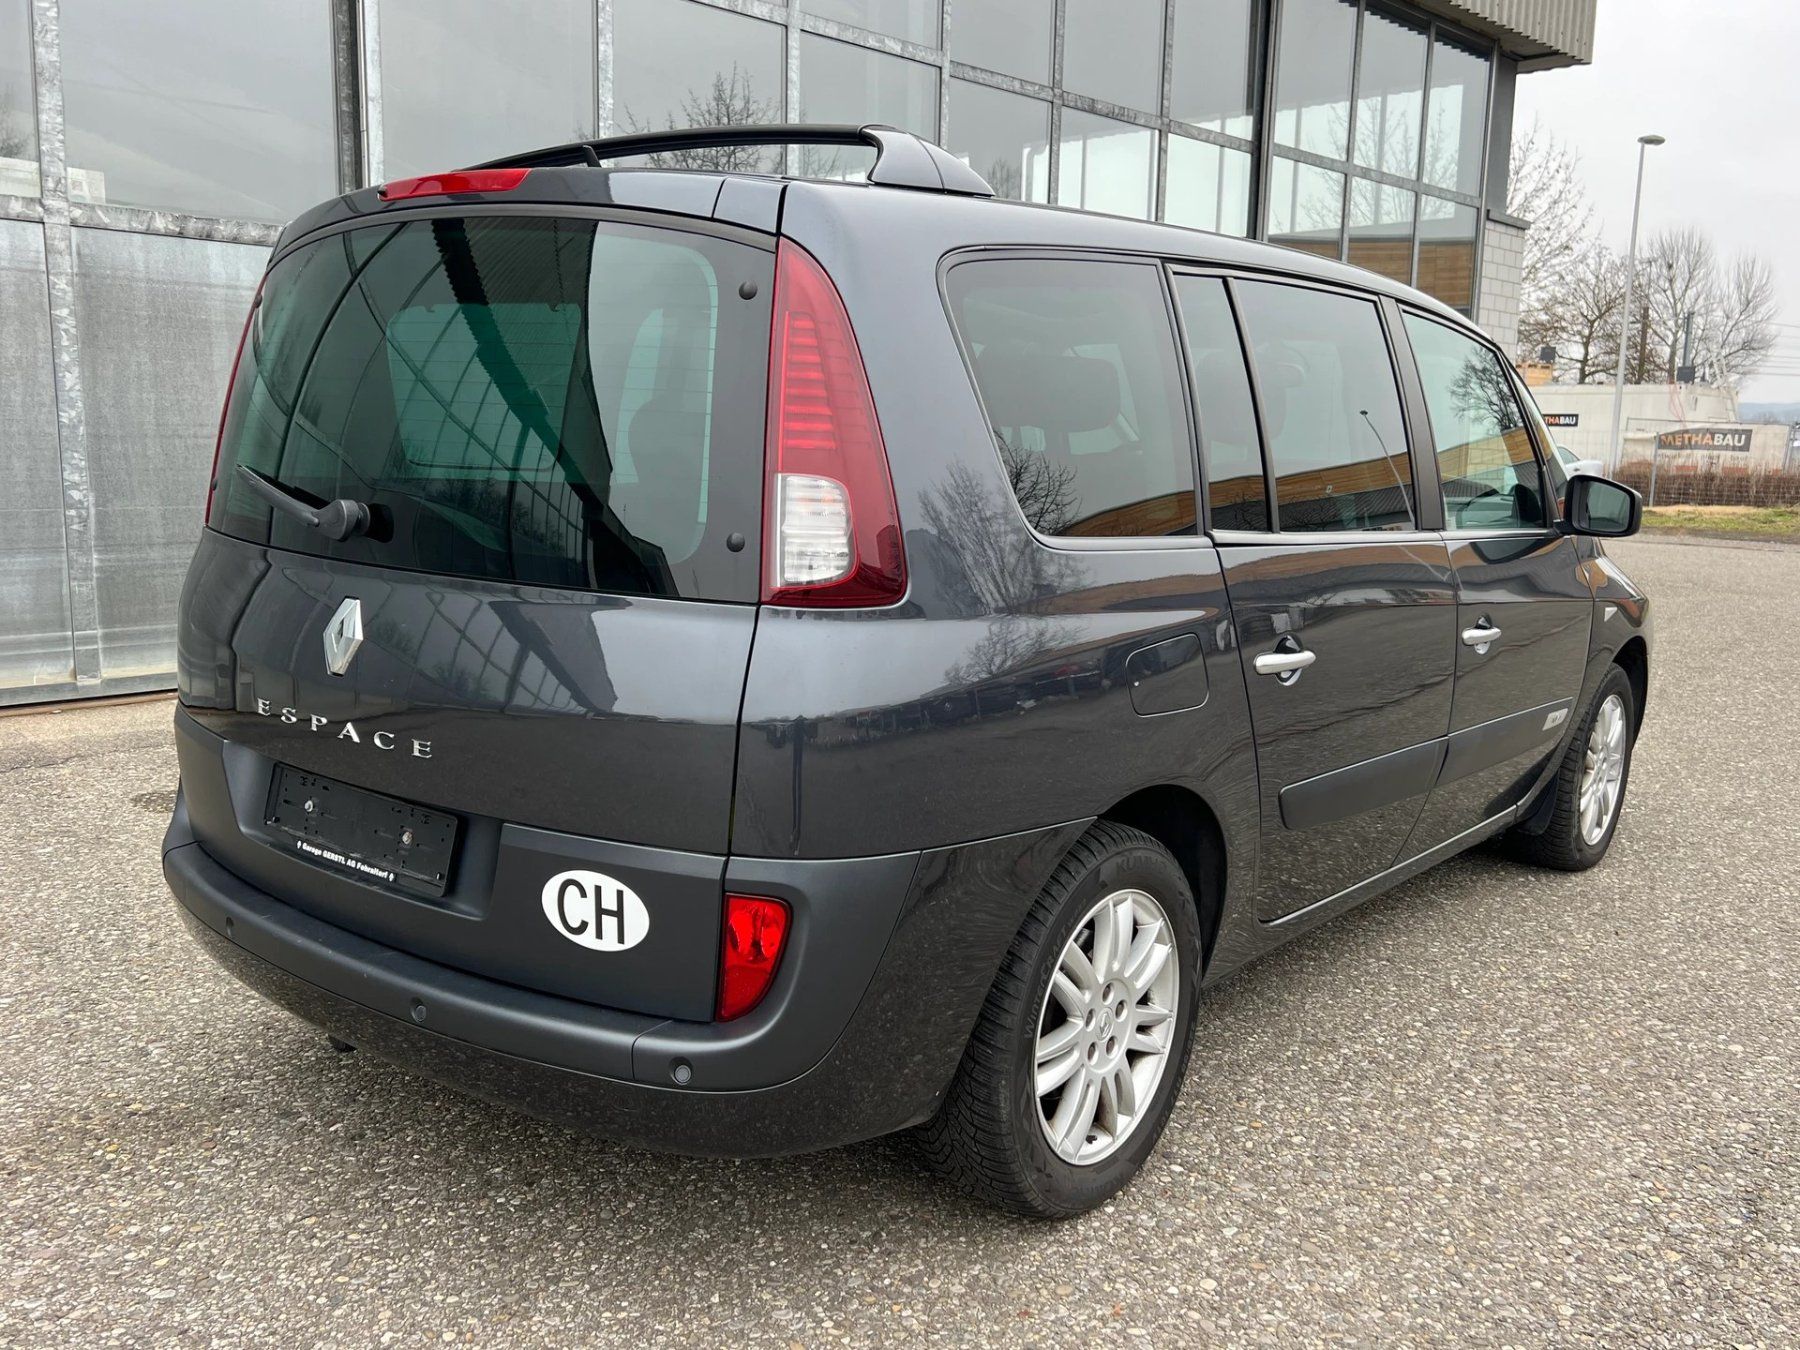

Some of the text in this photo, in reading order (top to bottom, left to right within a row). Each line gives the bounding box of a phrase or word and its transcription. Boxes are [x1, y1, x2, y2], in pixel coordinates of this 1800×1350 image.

[1544, 415, 1576, 425] THABAU
[1660, 432, 1746, 447] METHABAU
[257, 698, 433, 759] ESPACE
[302, 843, 322, 856] Garage
[323, 850, 345, 864] GERSTL
[347, 859, 356, 868] AG
[557, 878, 625, 945] CH
